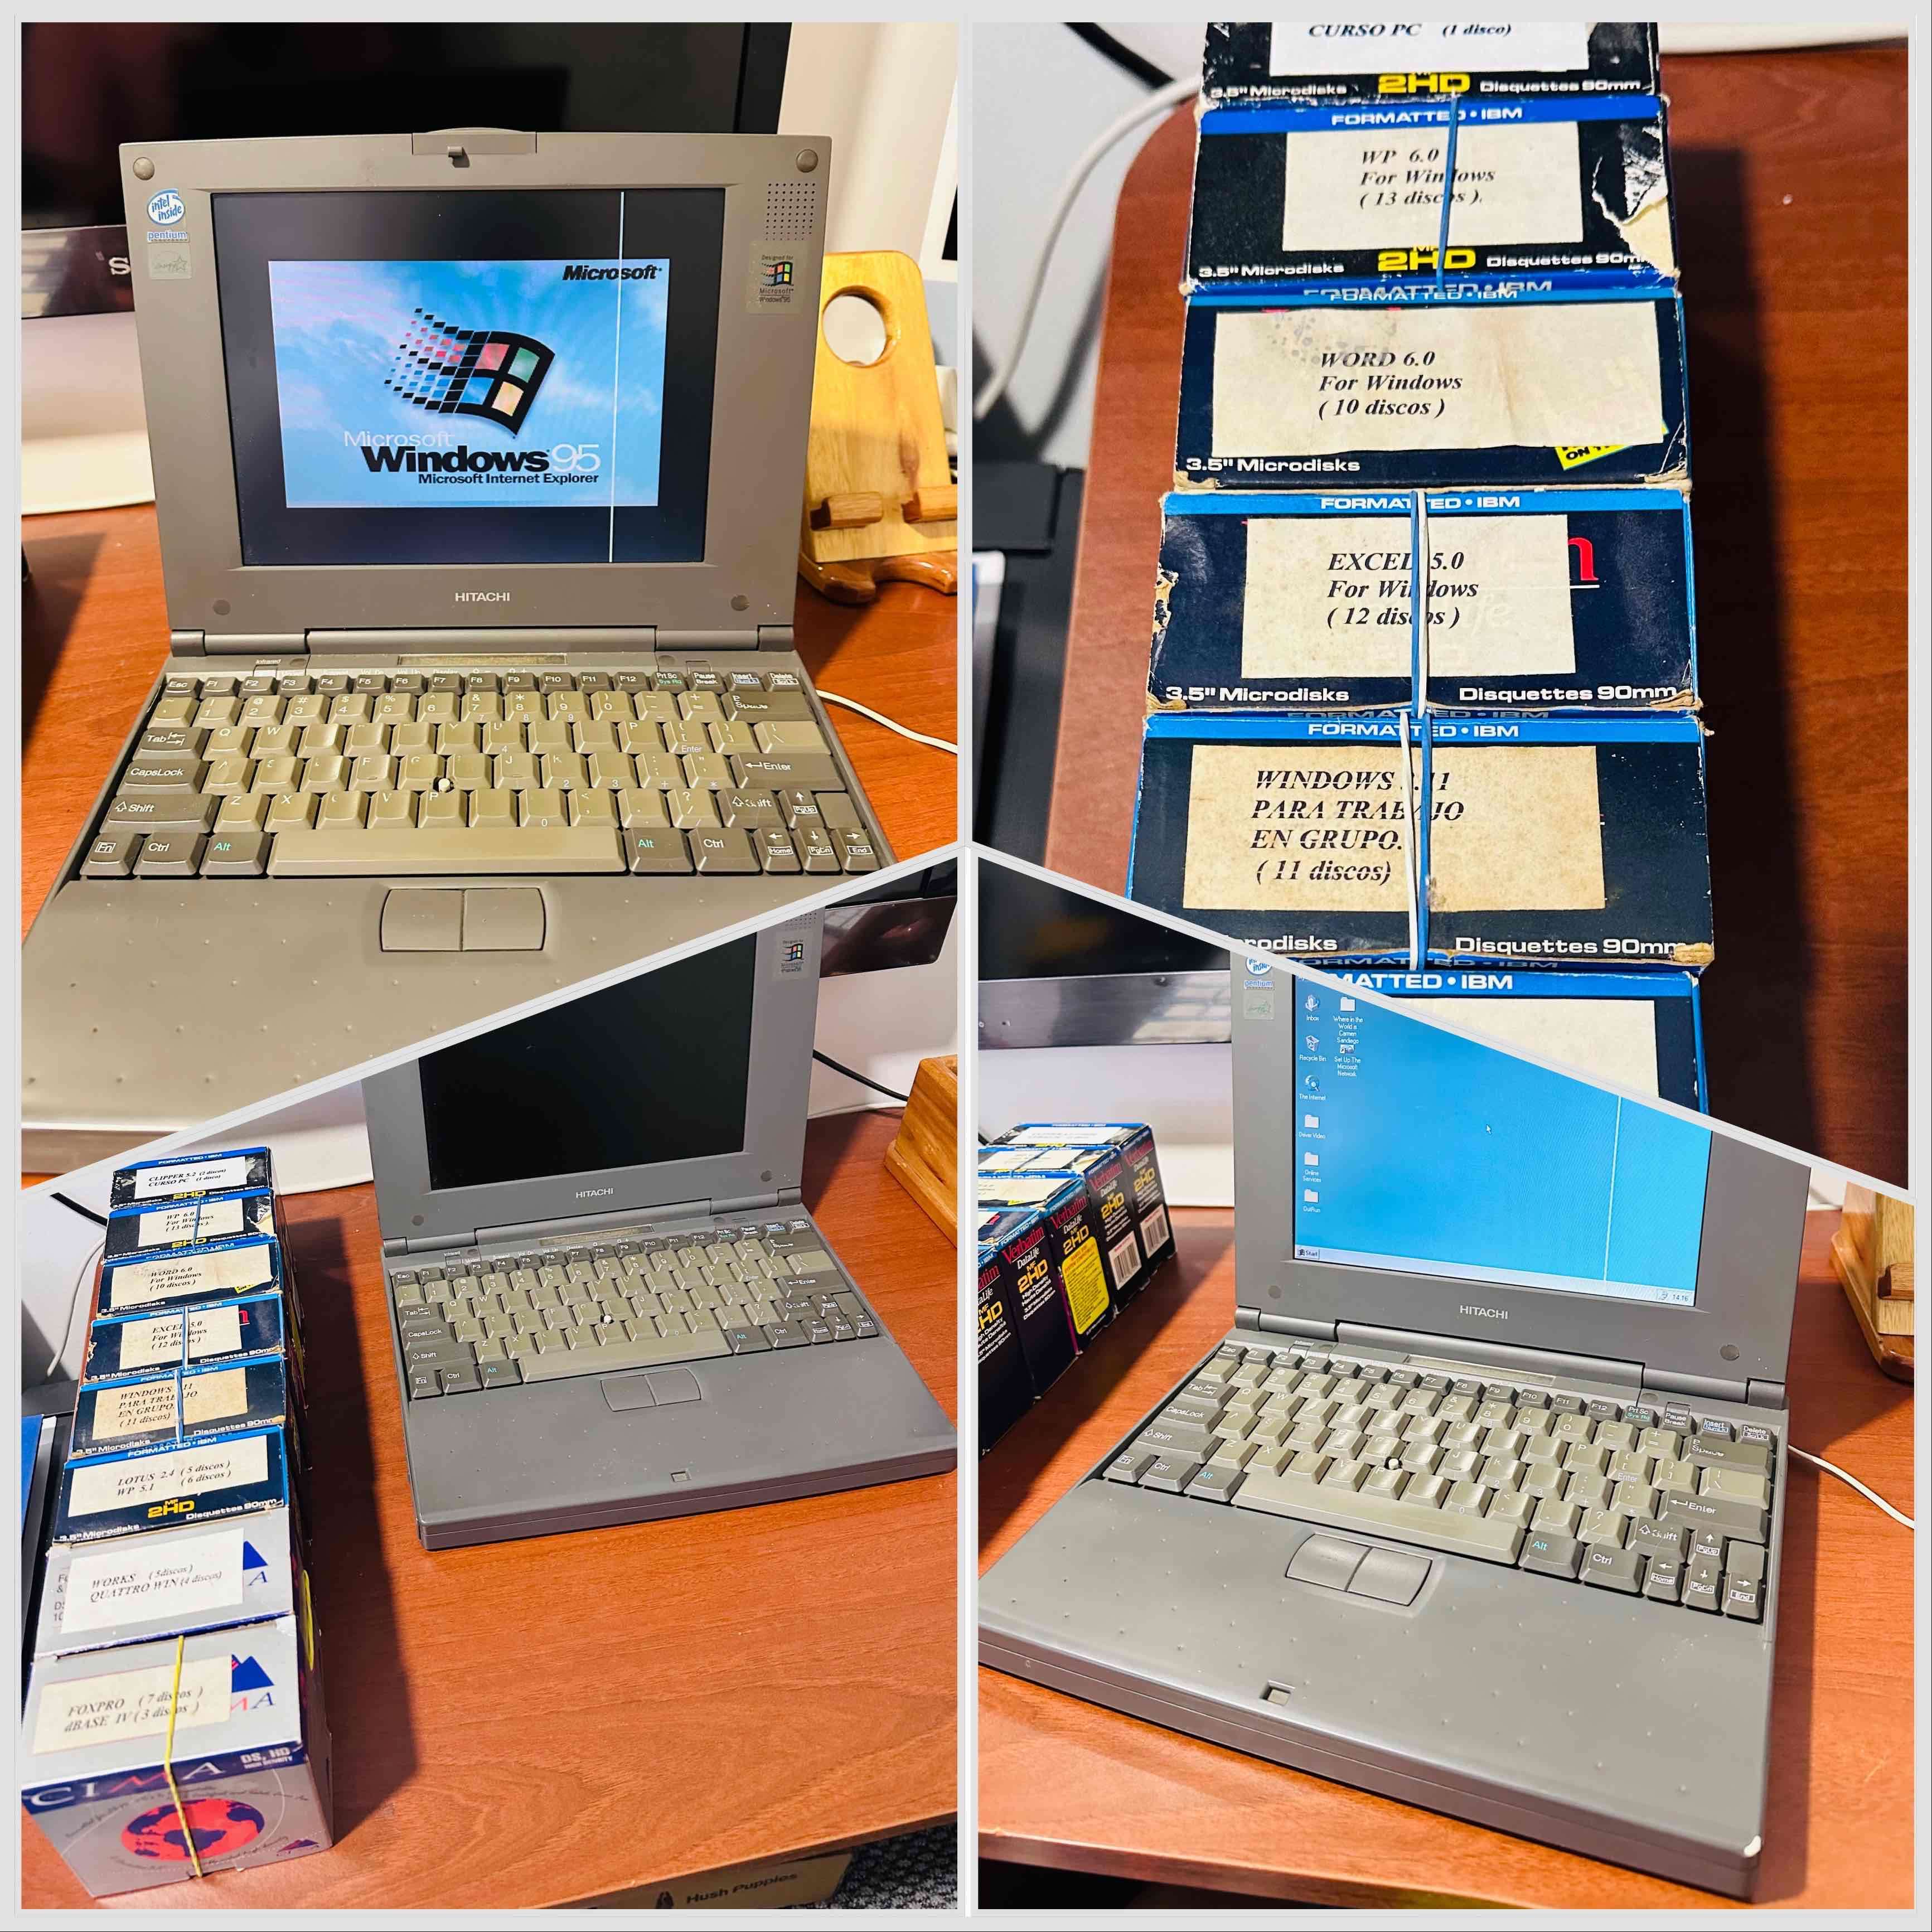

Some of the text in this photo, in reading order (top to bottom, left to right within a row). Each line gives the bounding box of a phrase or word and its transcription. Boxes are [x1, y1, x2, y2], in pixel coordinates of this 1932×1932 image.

[1309, 24, 1512, 37] CURSO PC disco)
[1250, 84, 1347, 97] Microdisks
[1378, 72, 1470, 94] 2HD
[1479, 81, 1579, 94] Disquettes
[1481, 107, 1522, 120] IBM
[1362, 147, 1440, 164] WP 6.0
[1360, 171, 1397, 186] For
[152, 195, 170, 212] intel
[1374, 192, 1397, 206] 13
[158, 204, 182, 221] inside
[148, 232, 187, 241] pentium
[1198, 248, 1593, 277] 3.5" Microdisks 2HD Disquettes
[562, 264, 656, 280] Microsoft
[1321, 351, 1436, 368] WORD 6.0
[1319, 374, 1463, 391] For Windows
[1334, 399, 1431, 416] 10 discos
[343, 431, 453, 447] Microsoft
[361, 444, 601, 473] Windows 95
[1186, 458, 1360, 472] 3.5" Microdisks
[418, 473, 599, 485] Microsoft Internet Explorer
[1476, 496, 1521, 509] IBM
[1431, 551, 1464, 570] 5.0
[1327, 580, 1369, 598] For
[454, 592, 510, 602] HITACHI
[1344, 607, 1370, 625] 12
[1166, 686, 1216, 701] 3.5"
[1219, 687, 1349, 702] Microdisks
[1459, 687, 1593, 703] Disquettes
[1474, 725, 1519, 737] IBM
[147, 734, 166, 743] Tab
[130, 768, 183, 778] CapsLock
[763, 762, 791, 772] Enter
[1256, 770, 1395, 790] WINDOWS
[128, 803, 154, 813] Shift
[1251, 800, 1324, 819] PARA
[214, 842, 231, 851] Alt
[638, 839, 654, 848] Alt
[703, 839, 724, 848] Ctrl
[1249, 829, 1402, 850] EN GRUPO.
[148, 842, 170, 852] Ctrl
[1274, 860, 1391, 886] 11 discos)
[1455, 937, 1598, 955] Disquettes
[1245, 979, 1274, 988] pentium
[1461, 974, 1513, 990] IBM
[158, 1156, 204, 1165] FORMATTED
[148, 1173, 184, 1182] CLIPPER
[173, 1190, 206, 1199] 2HD
[575, 1188, 614, 1198] HITACHI
[1049, 1195, 1087, 1229] Verbatim
[1101, 1192, 1125, 1219] 2HD
[1063, 1213, 1083, 1234] DataLife
[1002, 1226, 1044, 1264] Verbatim
[1063, 1224, 1089, 1255] 2HD
[1016, 1247, 1040, 1270] DataLife
[151, 1269, 179, 1277] WORD
[167, 1272, 202, 1281] Windows
[1017, 1258, 1048, 1294] 2HD
[119, 1301, 166, 1311] Microdisks
[1459, 1305, 1509, 1320] HITACHI
[408, 1329, 442, 1337] CapsLock
[200, 1353, 249, 1364] Disquettes
[120, 1386, 172, 1401] WINDOWS
[119, 1400, 146, 1410] PARA
[1166, 1406, 1205, 1418] CapsLock
[1665, 1412, 1687, 1421] Pause
[1154, 1431, 1173, 1440] Shift
[1743, 1425, 1767, 1435] Delete
[127, 1436, 217, 1458] FORMATTED IBM
[1155, 1462, 1170, 1471] Ctrl
[117, 1473, 155, 1486] LOTUS
[1199, 1471, 1214, 1480] Alt
[117, 1486, 135, 1497] WP
[147, 1500, 195, 1519] 2HD
[1688, 1502, 1717, 1515] Enter
[83, 1507, 243, 1541] Microdisks Disquettes
[1532, 1540, 1548, 1551] Alt
[1592, 1552, 1613, 1566] Ctrl
[91, 1573, 137, 1589] WORKS
[89, 1577, 178, 1603] QUATTRO WIN
[67, 1698, 125, 1717] FOXPRO
[64, 1715, 109, 1733] dBASE
[269, 1746, 290, 1758] HD
[686, 1873, 797, 1904] Hush Puppies
